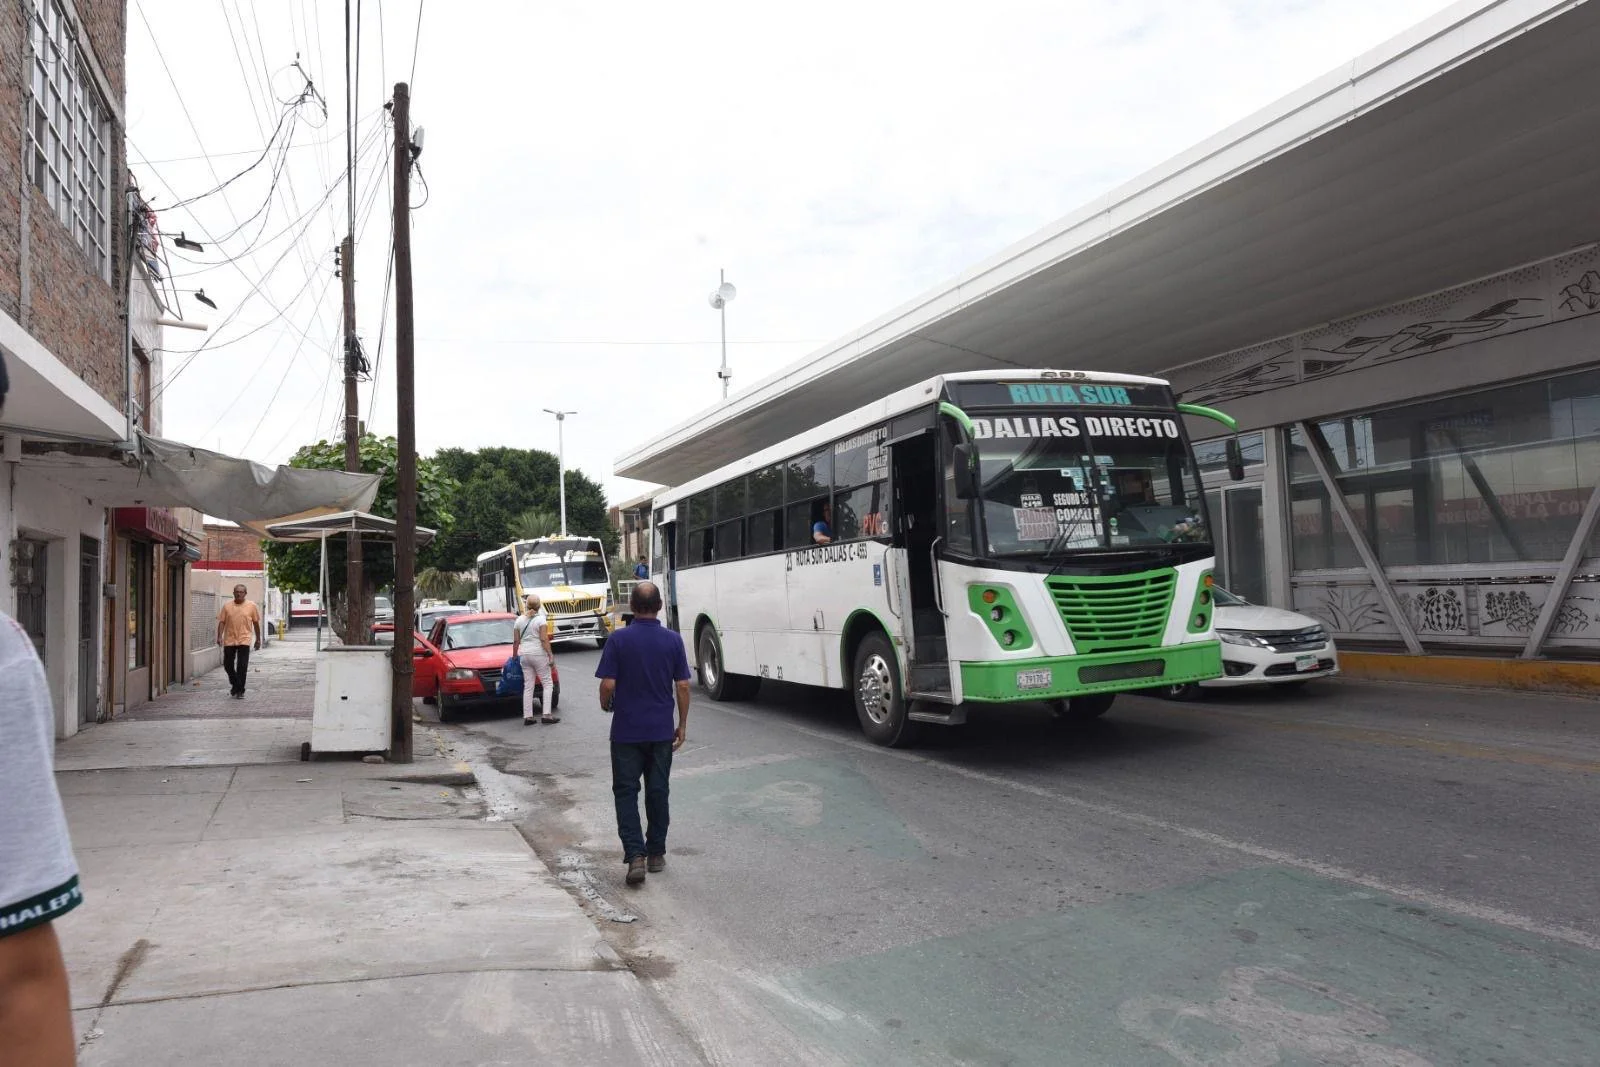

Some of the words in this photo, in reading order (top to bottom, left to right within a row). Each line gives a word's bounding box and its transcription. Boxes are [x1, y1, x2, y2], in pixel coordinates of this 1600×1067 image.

[1008, 384, 1080, 404] RUTA
[1079, 385, 1131, 405] SUR
[857, 426, 888, 447] DIRECTO
[974, 417, 1080, 439] DALIAS
[1084, 416, 1179, 438] DIRECTO
[1053, 493, 1080, 505] SEGURO
[796, 549, 810, 566] RUTA
[812, 548, 823, 565] SUR
[825, 544, 847, 563] DALIAS
